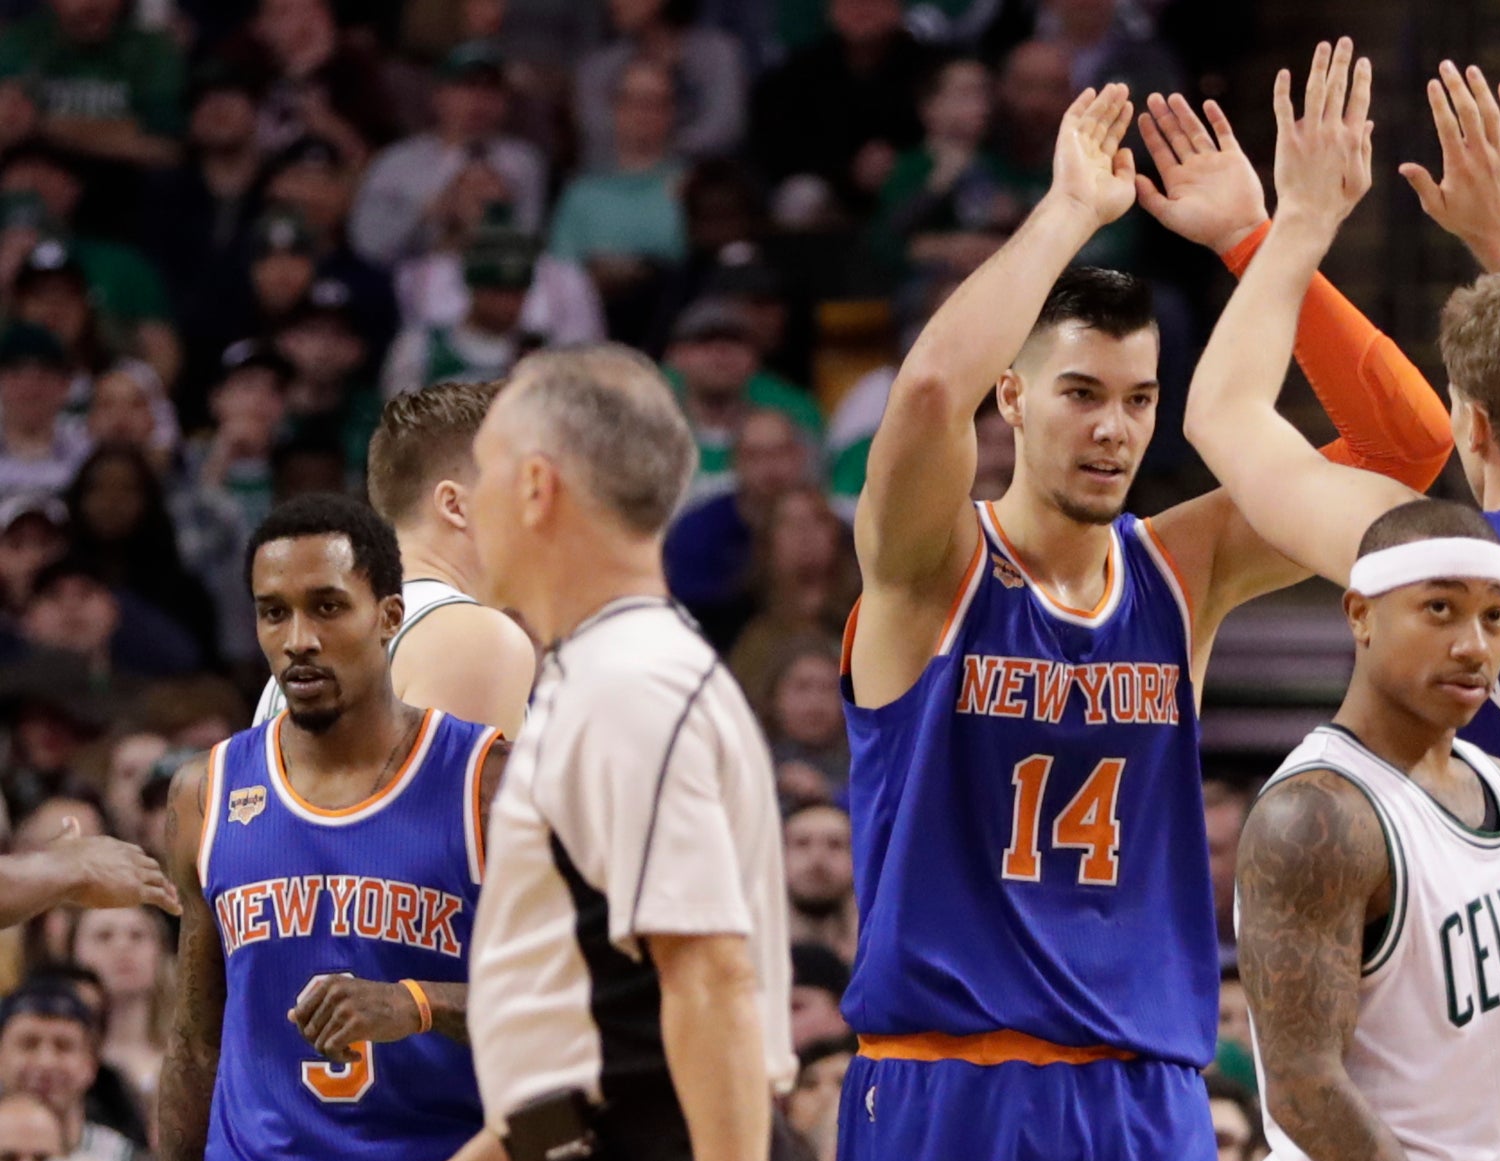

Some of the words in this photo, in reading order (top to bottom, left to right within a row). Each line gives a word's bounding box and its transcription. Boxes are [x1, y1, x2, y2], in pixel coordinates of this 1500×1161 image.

[956, 654, 1074, 724] NEW
[1074, 663, 1180, 726] YORK
[1001, 753, 1127, 886] 14
[215, 875, 324, 958] NEW
[326, 875, 463, 959] YORK
